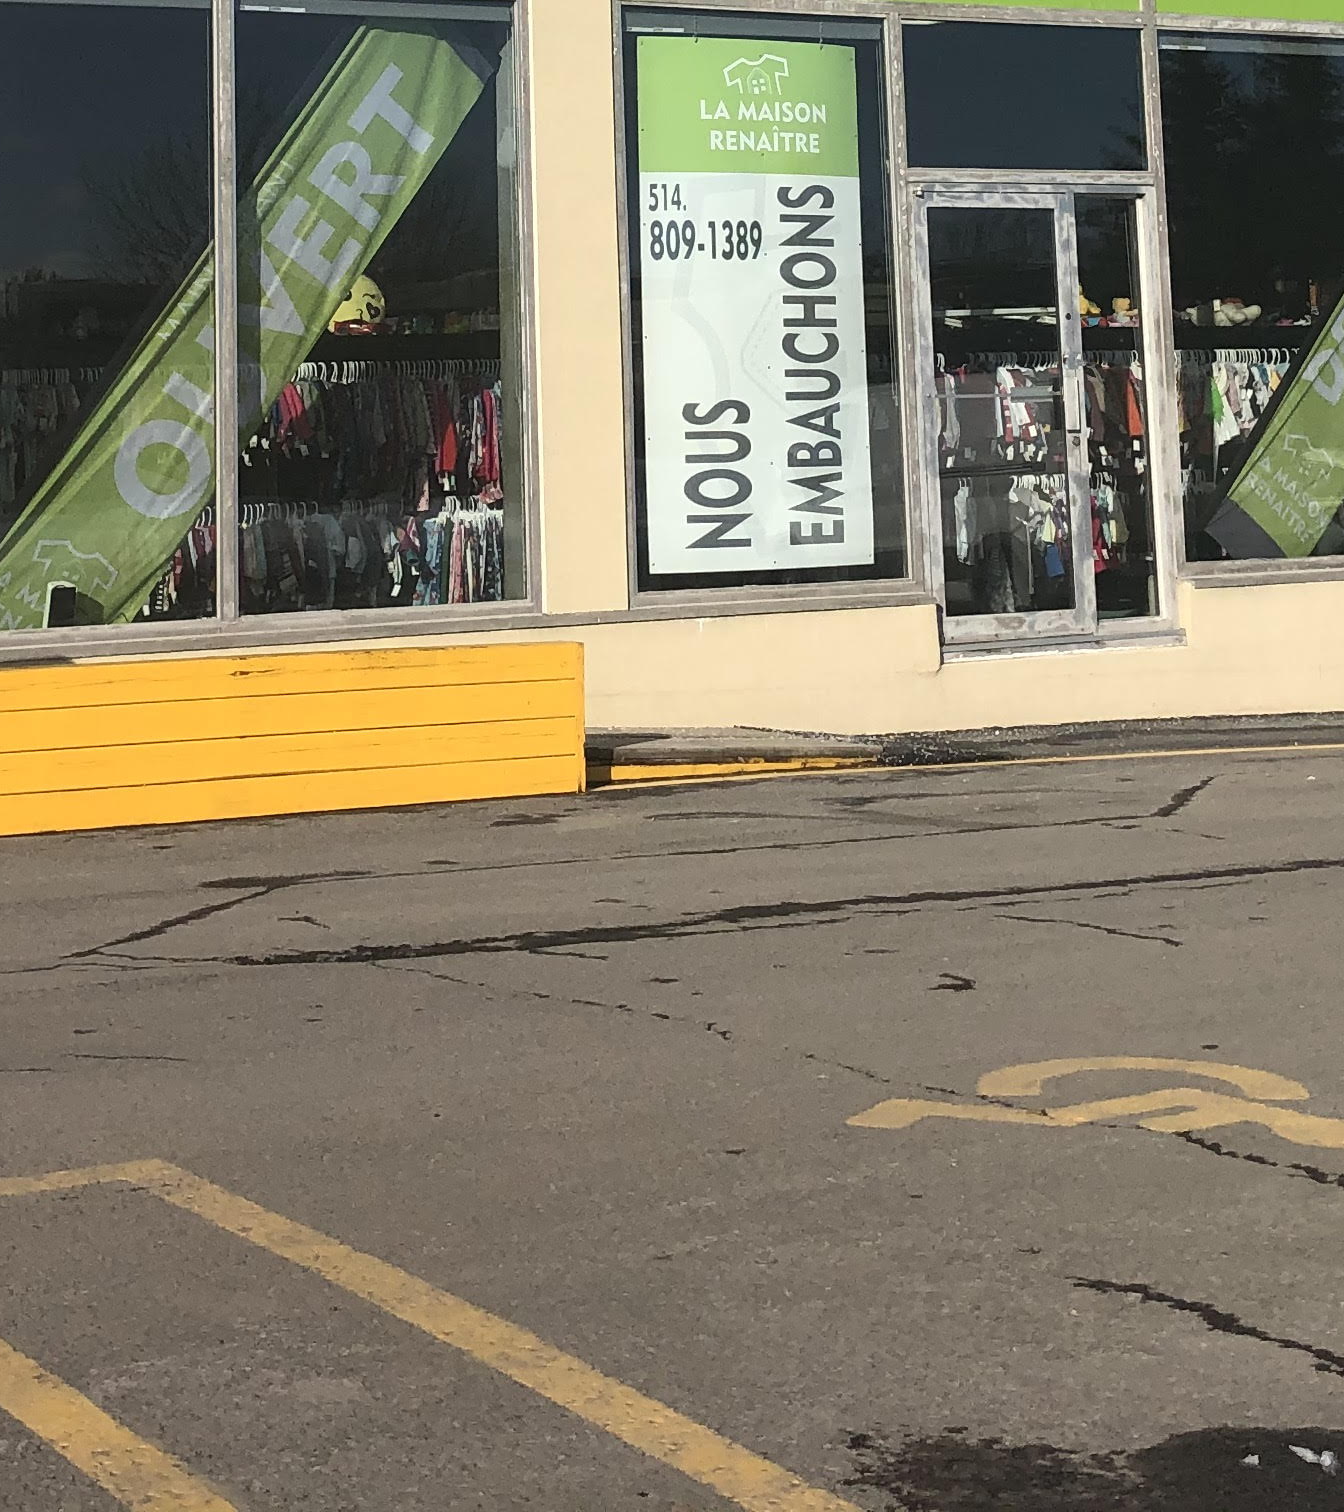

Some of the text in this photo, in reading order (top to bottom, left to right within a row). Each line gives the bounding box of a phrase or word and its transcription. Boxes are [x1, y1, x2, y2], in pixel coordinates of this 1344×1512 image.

[699, 99, 827, 124] LA MAISON
[709, 125, 820, 154] RENAÎTRE
[649, 220, 763, 261] 809-1389
[776, 184, 845, 546] EMBAUCHONS
[682, 399, 754, 549] NOUS
